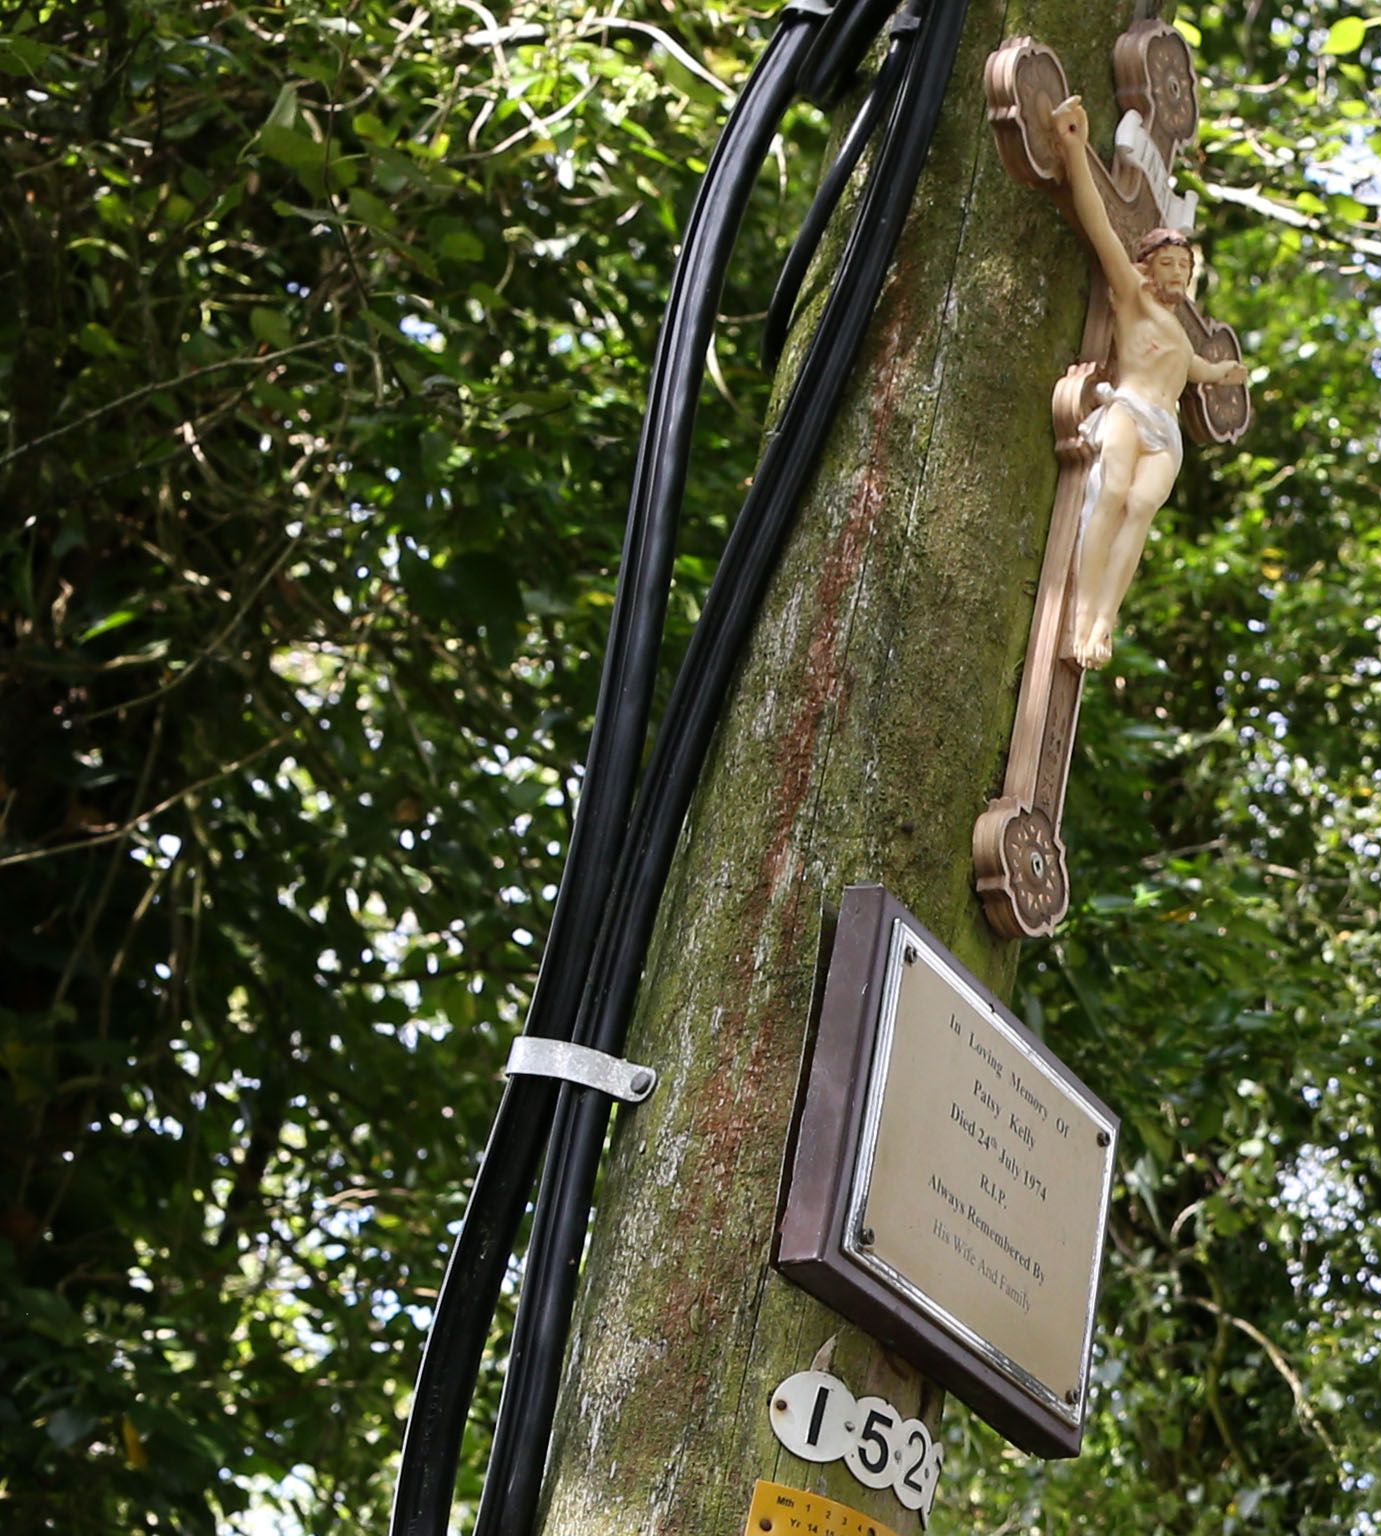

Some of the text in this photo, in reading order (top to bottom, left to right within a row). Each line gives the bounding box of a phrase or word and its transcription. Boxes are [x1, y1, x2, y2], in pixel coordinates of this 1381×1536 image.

[949, 1013, 1070, 1139] In Loving Memory Of
[973, 1079, 1036, 1151] Patsy Kelly
[950, 1102, 976, 1138] Died
[998, 1148, 1021, 1181] July
[1023, 1170, 1048, 1202] 1974
[980, 1173, 1008, 1210] R.I.P.
[928, 1173, 1047, 1287] Always Remembered By
[933, 1218, 1033, 1315] His Wife And Family
[776, 1496, 795, 1508] Mth
[806, 1504, 811, 1513] 1
[825, 1510, 832, 1519] 2
[790, 1518, 801, 1529] Yr
[807, 1523, 819, 1534] 14
